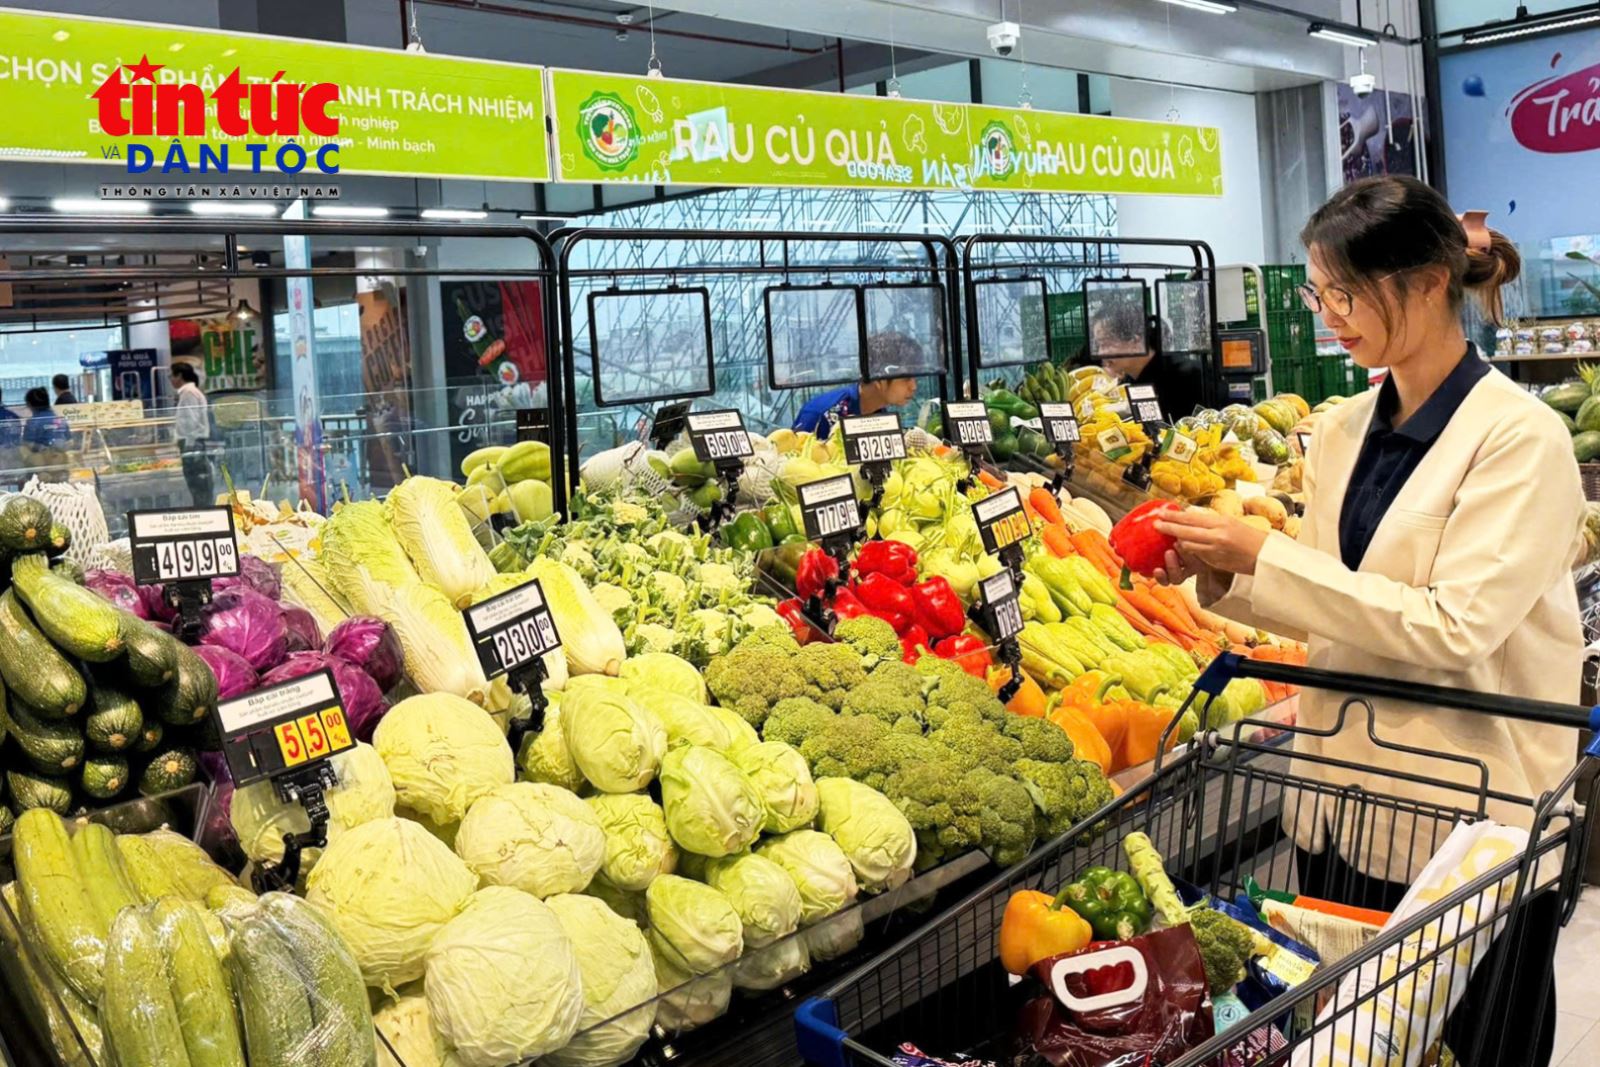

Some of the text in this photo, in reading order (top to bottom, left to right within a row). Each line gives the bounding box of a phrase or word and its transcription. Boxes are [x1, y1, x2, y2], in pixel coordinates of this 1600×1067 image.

[351, 115, 399, 130] nghiệp
[386, 87, 463, 114] TRÁCH
[468, 94, 534, 123] NHIỆM
[367, 135, 400, 149] Minh
[403, 138, 436, 153] bạch
[673, 119, 755, 163] RAU
[764, 113, 816, 166] CỦ
[824, 119, 898, 168] QUẢ
[1036, 135, 1176, 179] RAU CỦ QUẢ
